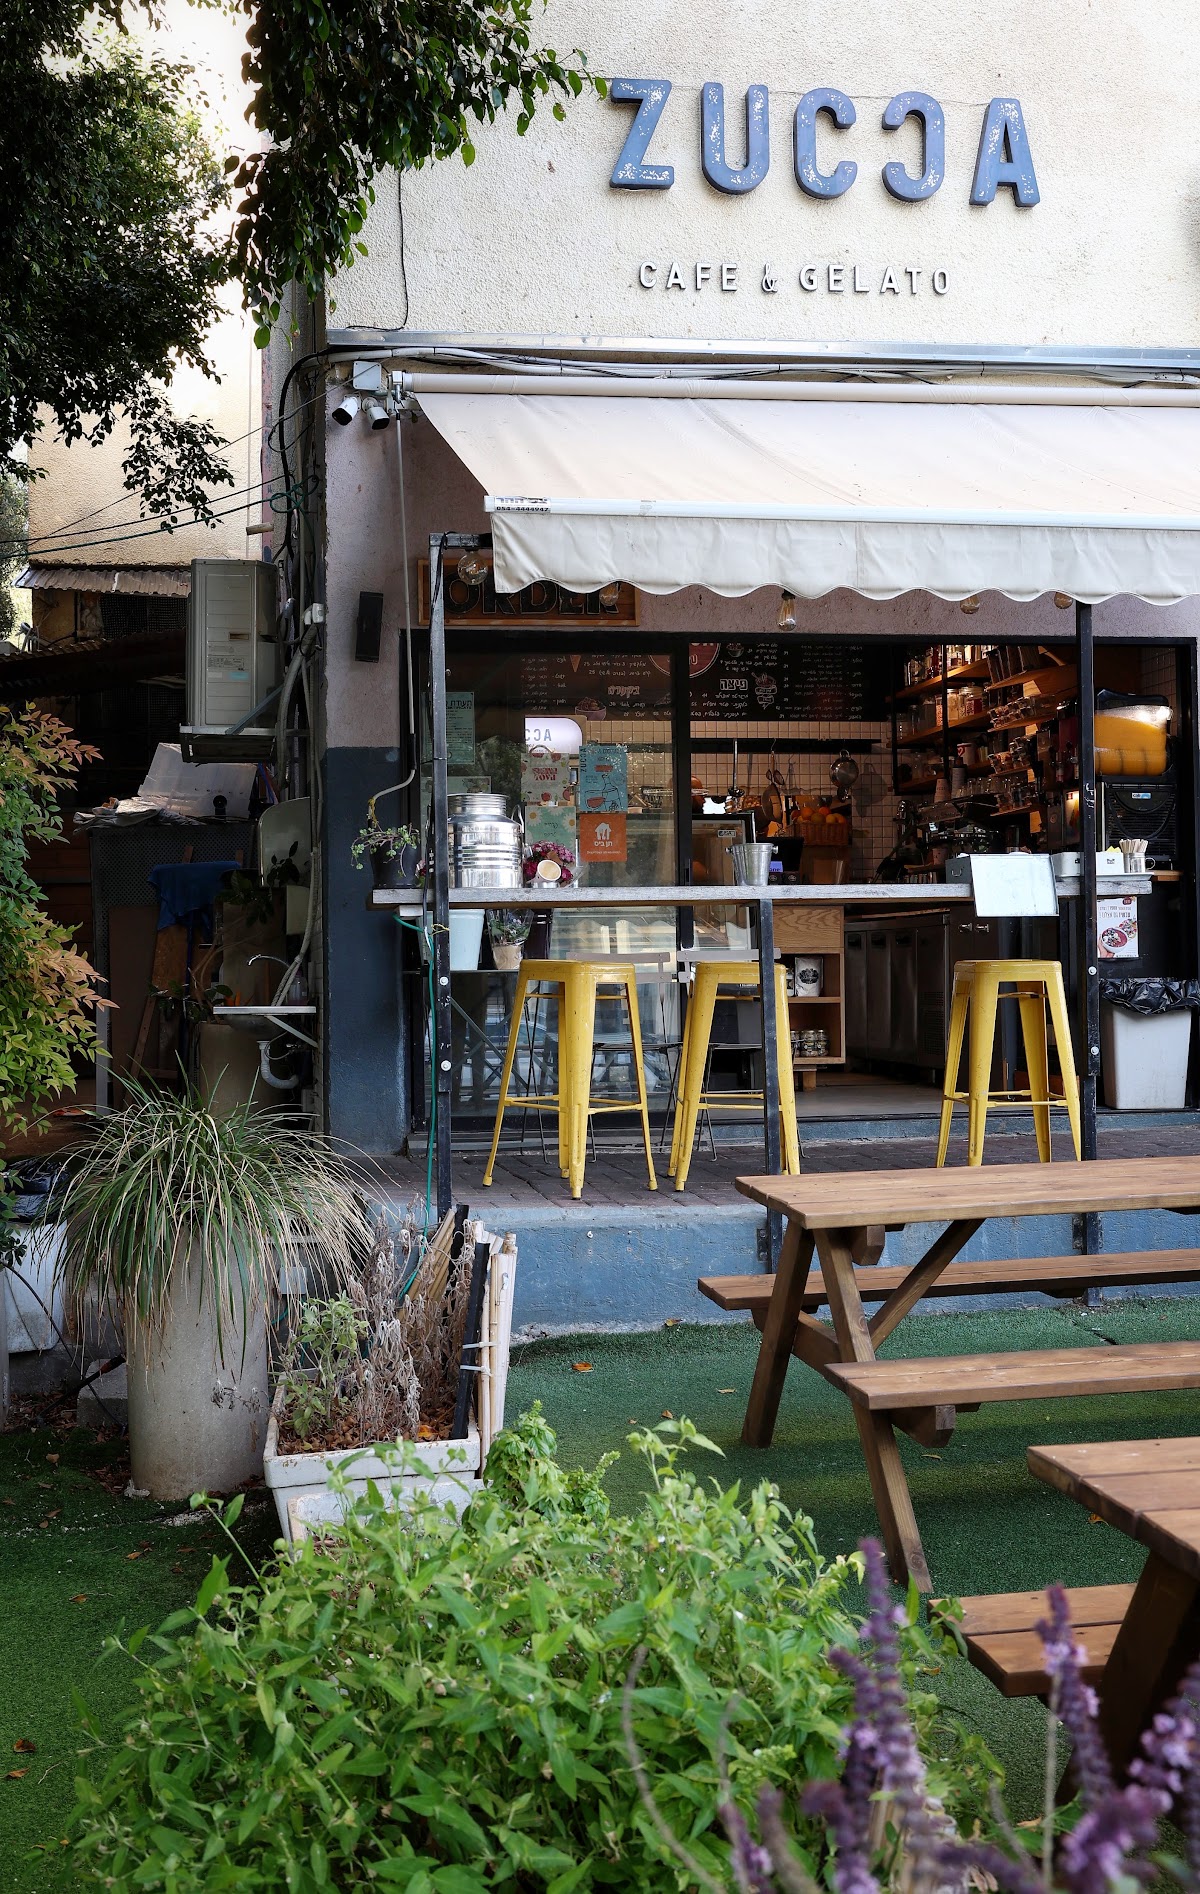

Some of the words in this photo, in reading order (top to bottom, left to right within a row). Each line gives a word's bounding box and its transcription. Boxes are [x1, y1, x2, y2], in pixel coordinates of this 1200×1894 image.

[609, 78, 1041, 208] ZUCCA
[639, 260, 739, 292] CAFE
[761, 262, 778, 293] &
[799, 263, 951, 296] GELATO
[720, 679, 748, 690] פיצה
